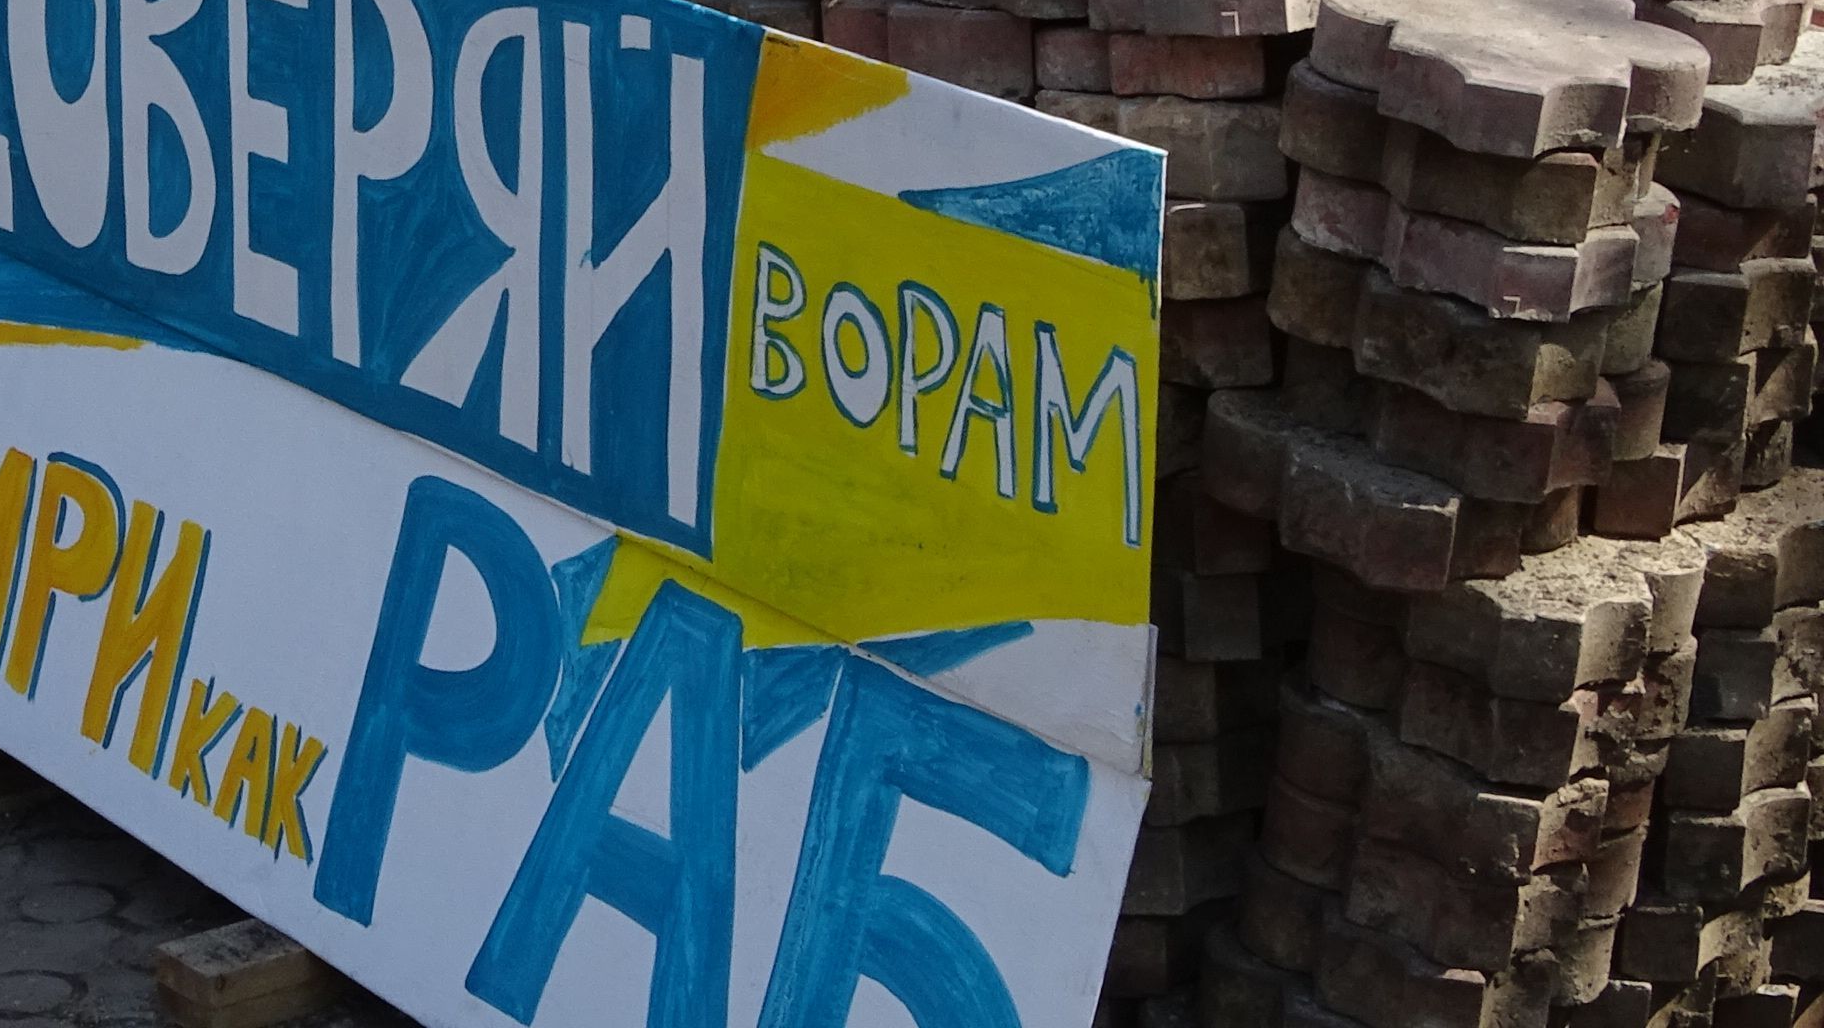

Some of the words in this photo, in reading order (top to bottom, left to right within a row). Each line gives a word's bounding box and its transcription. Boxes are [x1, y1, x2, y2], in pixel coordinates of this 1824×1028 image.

[748, 241, 1143, 550] ВОРАМ
[175, 674, 328, 866] КАК
[312, 473, 1092, 1028] РАБ
